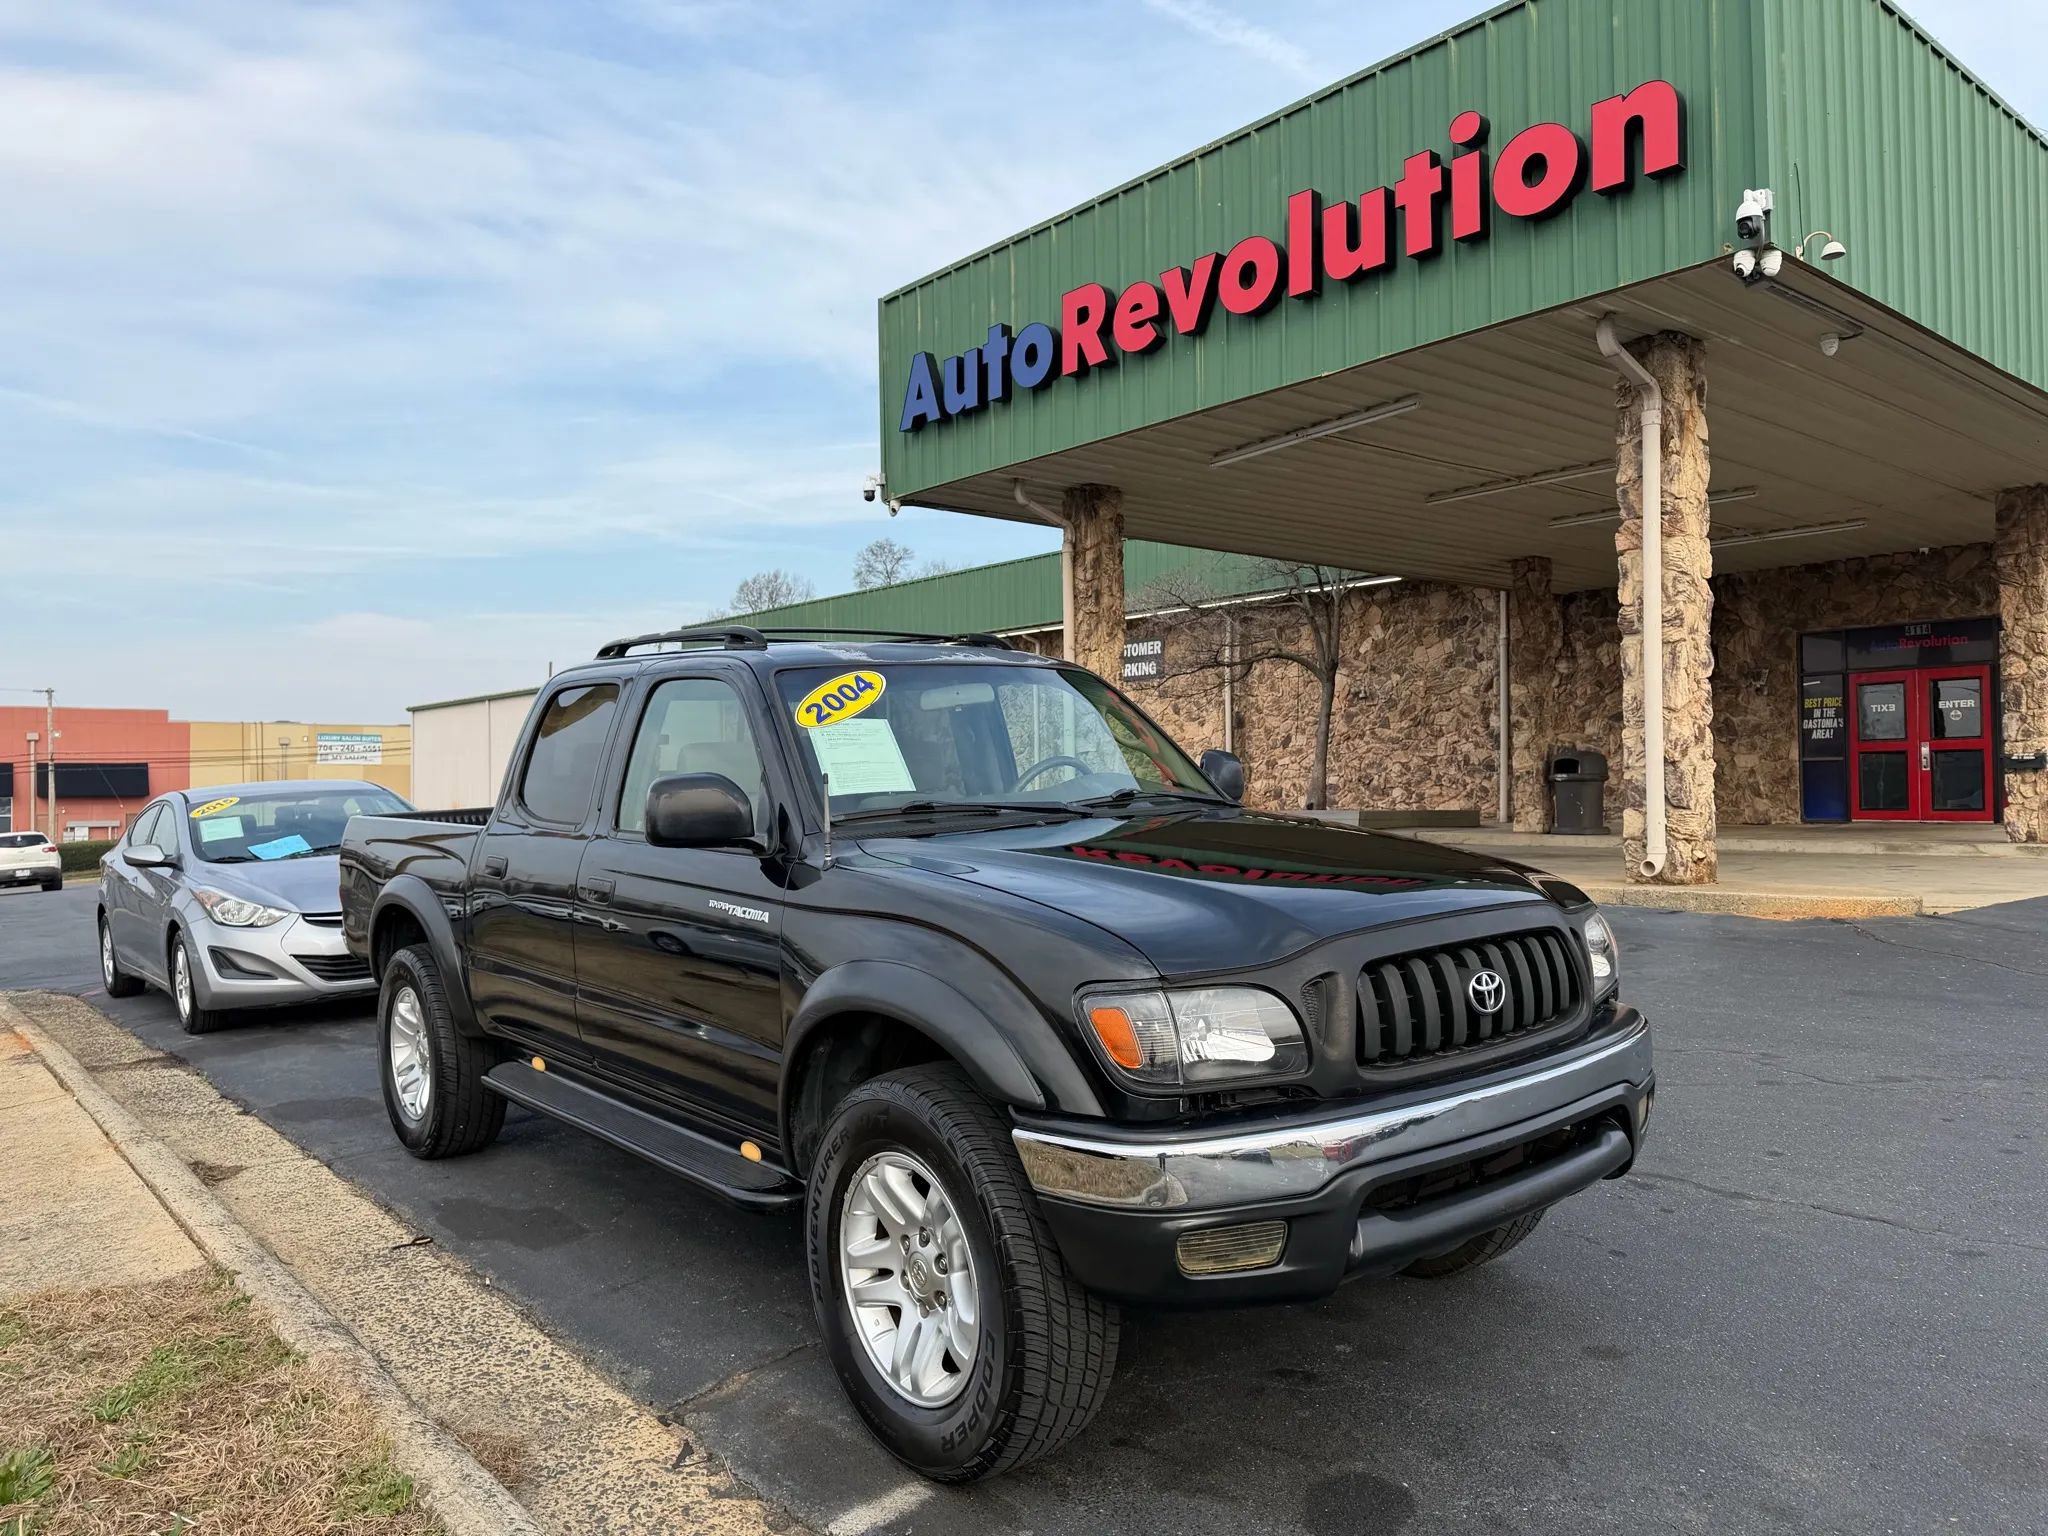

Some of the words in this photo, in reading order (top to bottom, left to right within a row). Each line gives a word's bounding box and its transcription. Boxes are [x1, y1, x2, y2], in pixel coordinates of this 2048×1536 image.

[1122, 661, 1157, 677] RKING
[806, 675, 874, 724] 2004
[1804, 698, 1822, 708] BEST
[1823, 696, 1843, 707] PRICE
[1938, 700, 1975, 709] ENTER
[1813, 708, 1821, 718] IN
[1823, 707, 1836, 718] THE
[1803, 718, 1844, 729] GASTONIA'S
[1811, 729, 1834, 739] AREA!
[728, 904, 770, 924] TACOMA
[808, 1126, 850, 1304] ADVENTURER
[941, 1328, 996, 1453] COOPER
